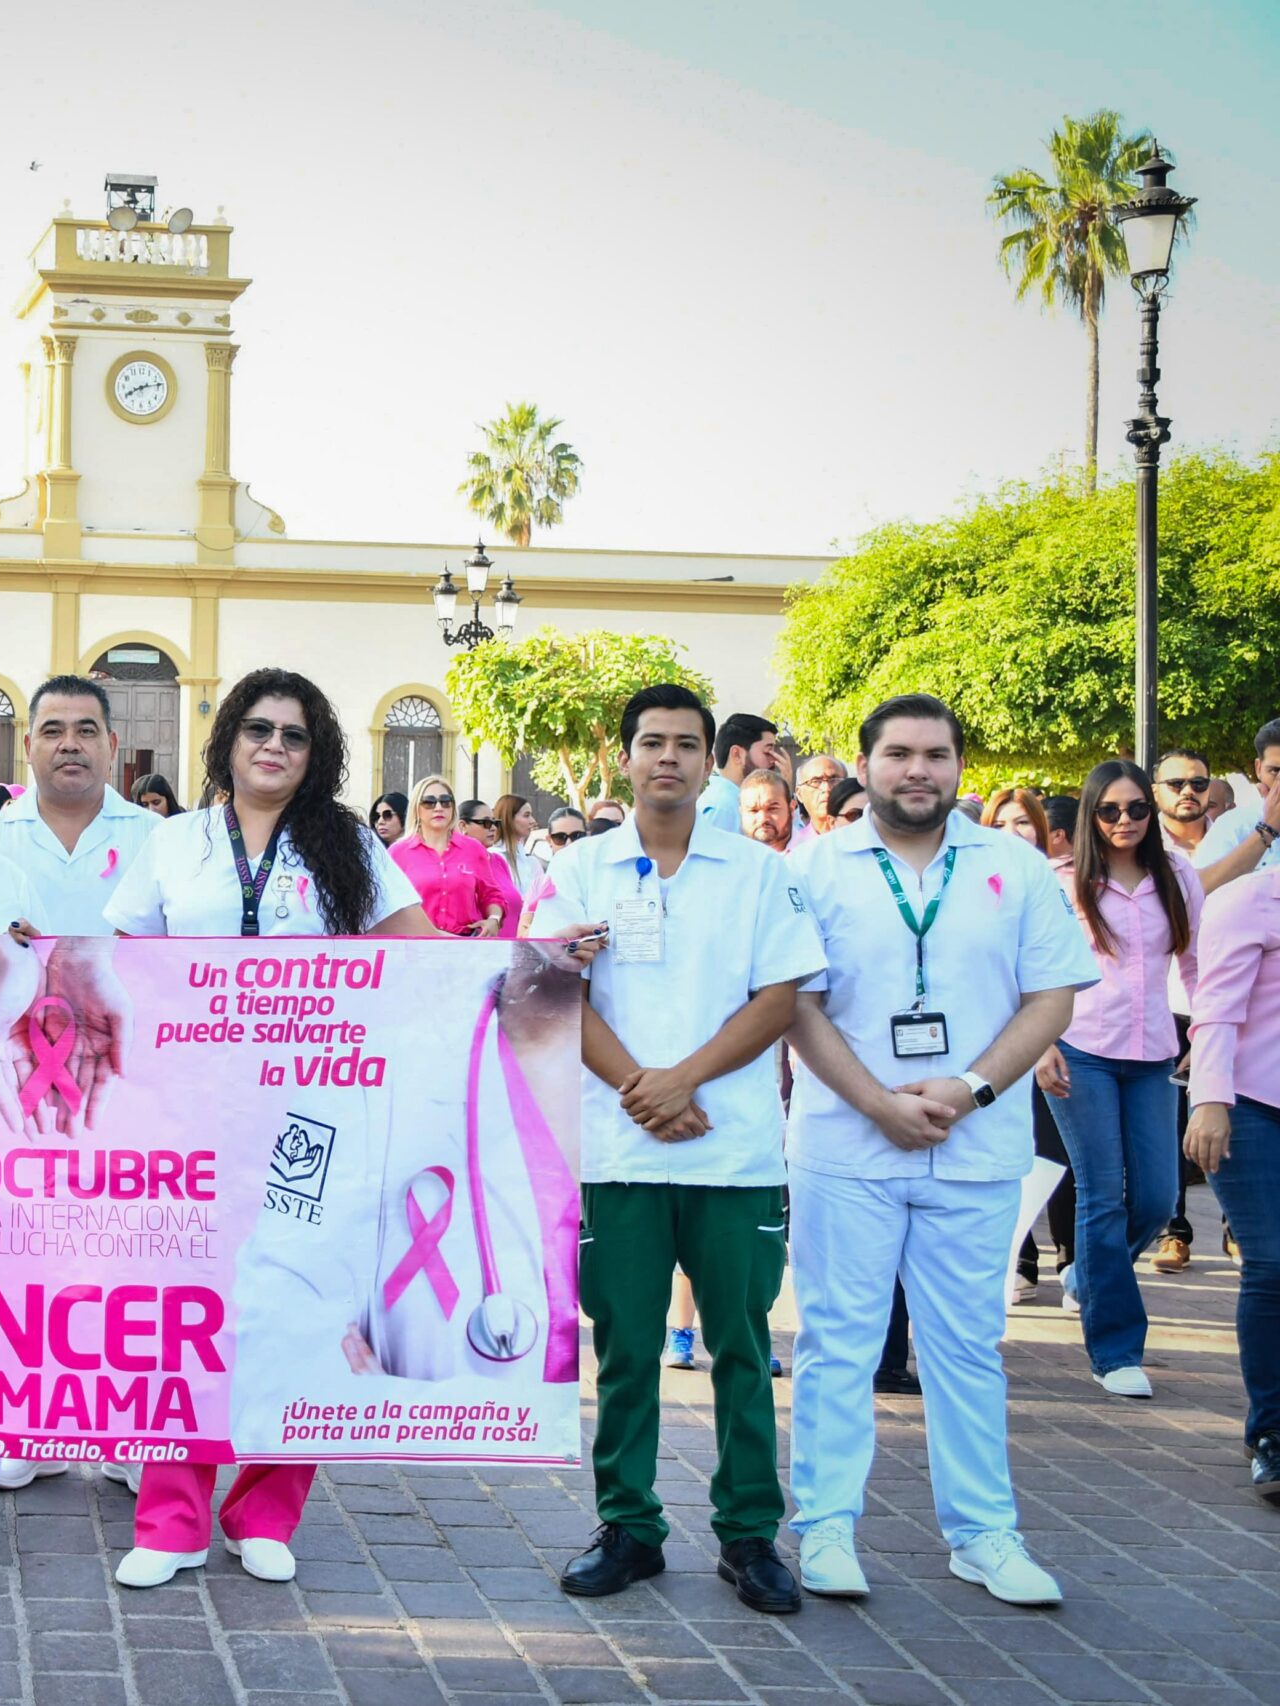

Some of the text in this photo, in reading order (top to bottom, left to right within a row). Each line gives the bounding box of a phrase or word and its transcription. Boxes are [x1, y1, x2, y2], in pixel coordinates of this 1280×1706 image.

[188, 950, 385, 990] Un control
[209, 989, 335, 1021] a tiempo
[155, 1018, 366, 1048] puede salvarte
[259, 1046, 387, 1088] la vida
[11, 1203, 219, 1233] INTERNACIONAL
[263, 1189, 325, 1226] SSTE
[84, 1234, 182, 1258] CONTRA
[190, 1235, 217, 1259] EL
[282, 1397, 531, 1426] ¡Únete a la campaña y
[282, 1422, 539, 1444] porta una prenda rosa!
[19, 1437, 106, 1460] Trátalo,
[114, 1439, 189, 1462] Cúralo
